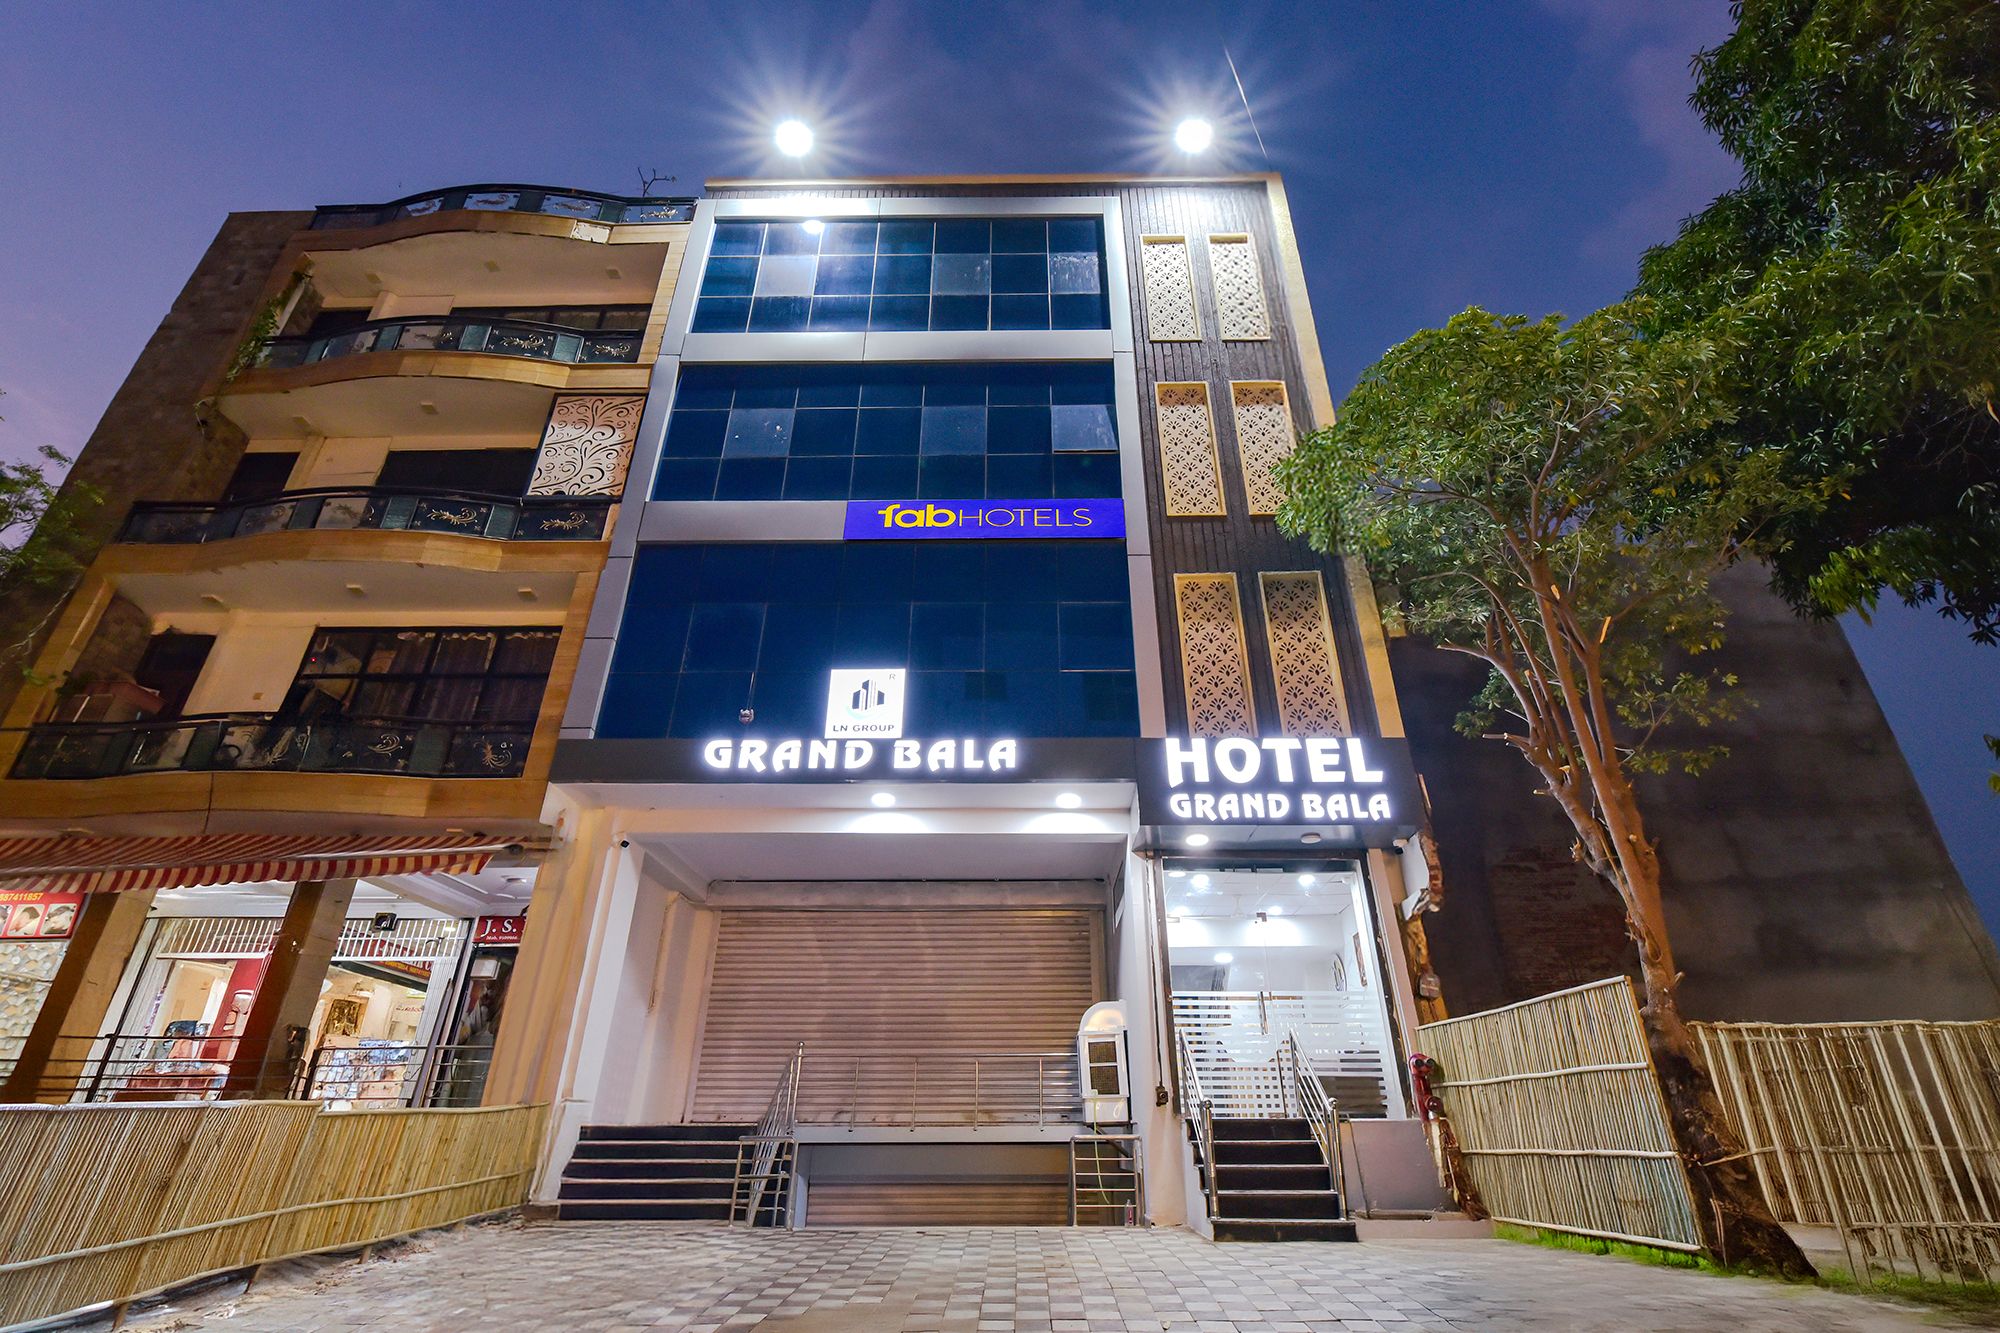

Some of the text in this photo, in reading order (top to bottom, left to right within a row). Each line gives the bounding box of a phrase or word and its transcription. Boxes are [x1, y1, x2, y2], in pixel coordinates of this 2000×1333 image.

[878, 504, 1092, 528] fabHOTELS
[703, 739, 1017, 773] GRAND BALA
[1165, 737, 1384, 788] HOTEL
[1169, 793, 1391, 822] GRAND BALA
[480, 919, 497, 938] J.
[502, 919, 517, 933] S.
